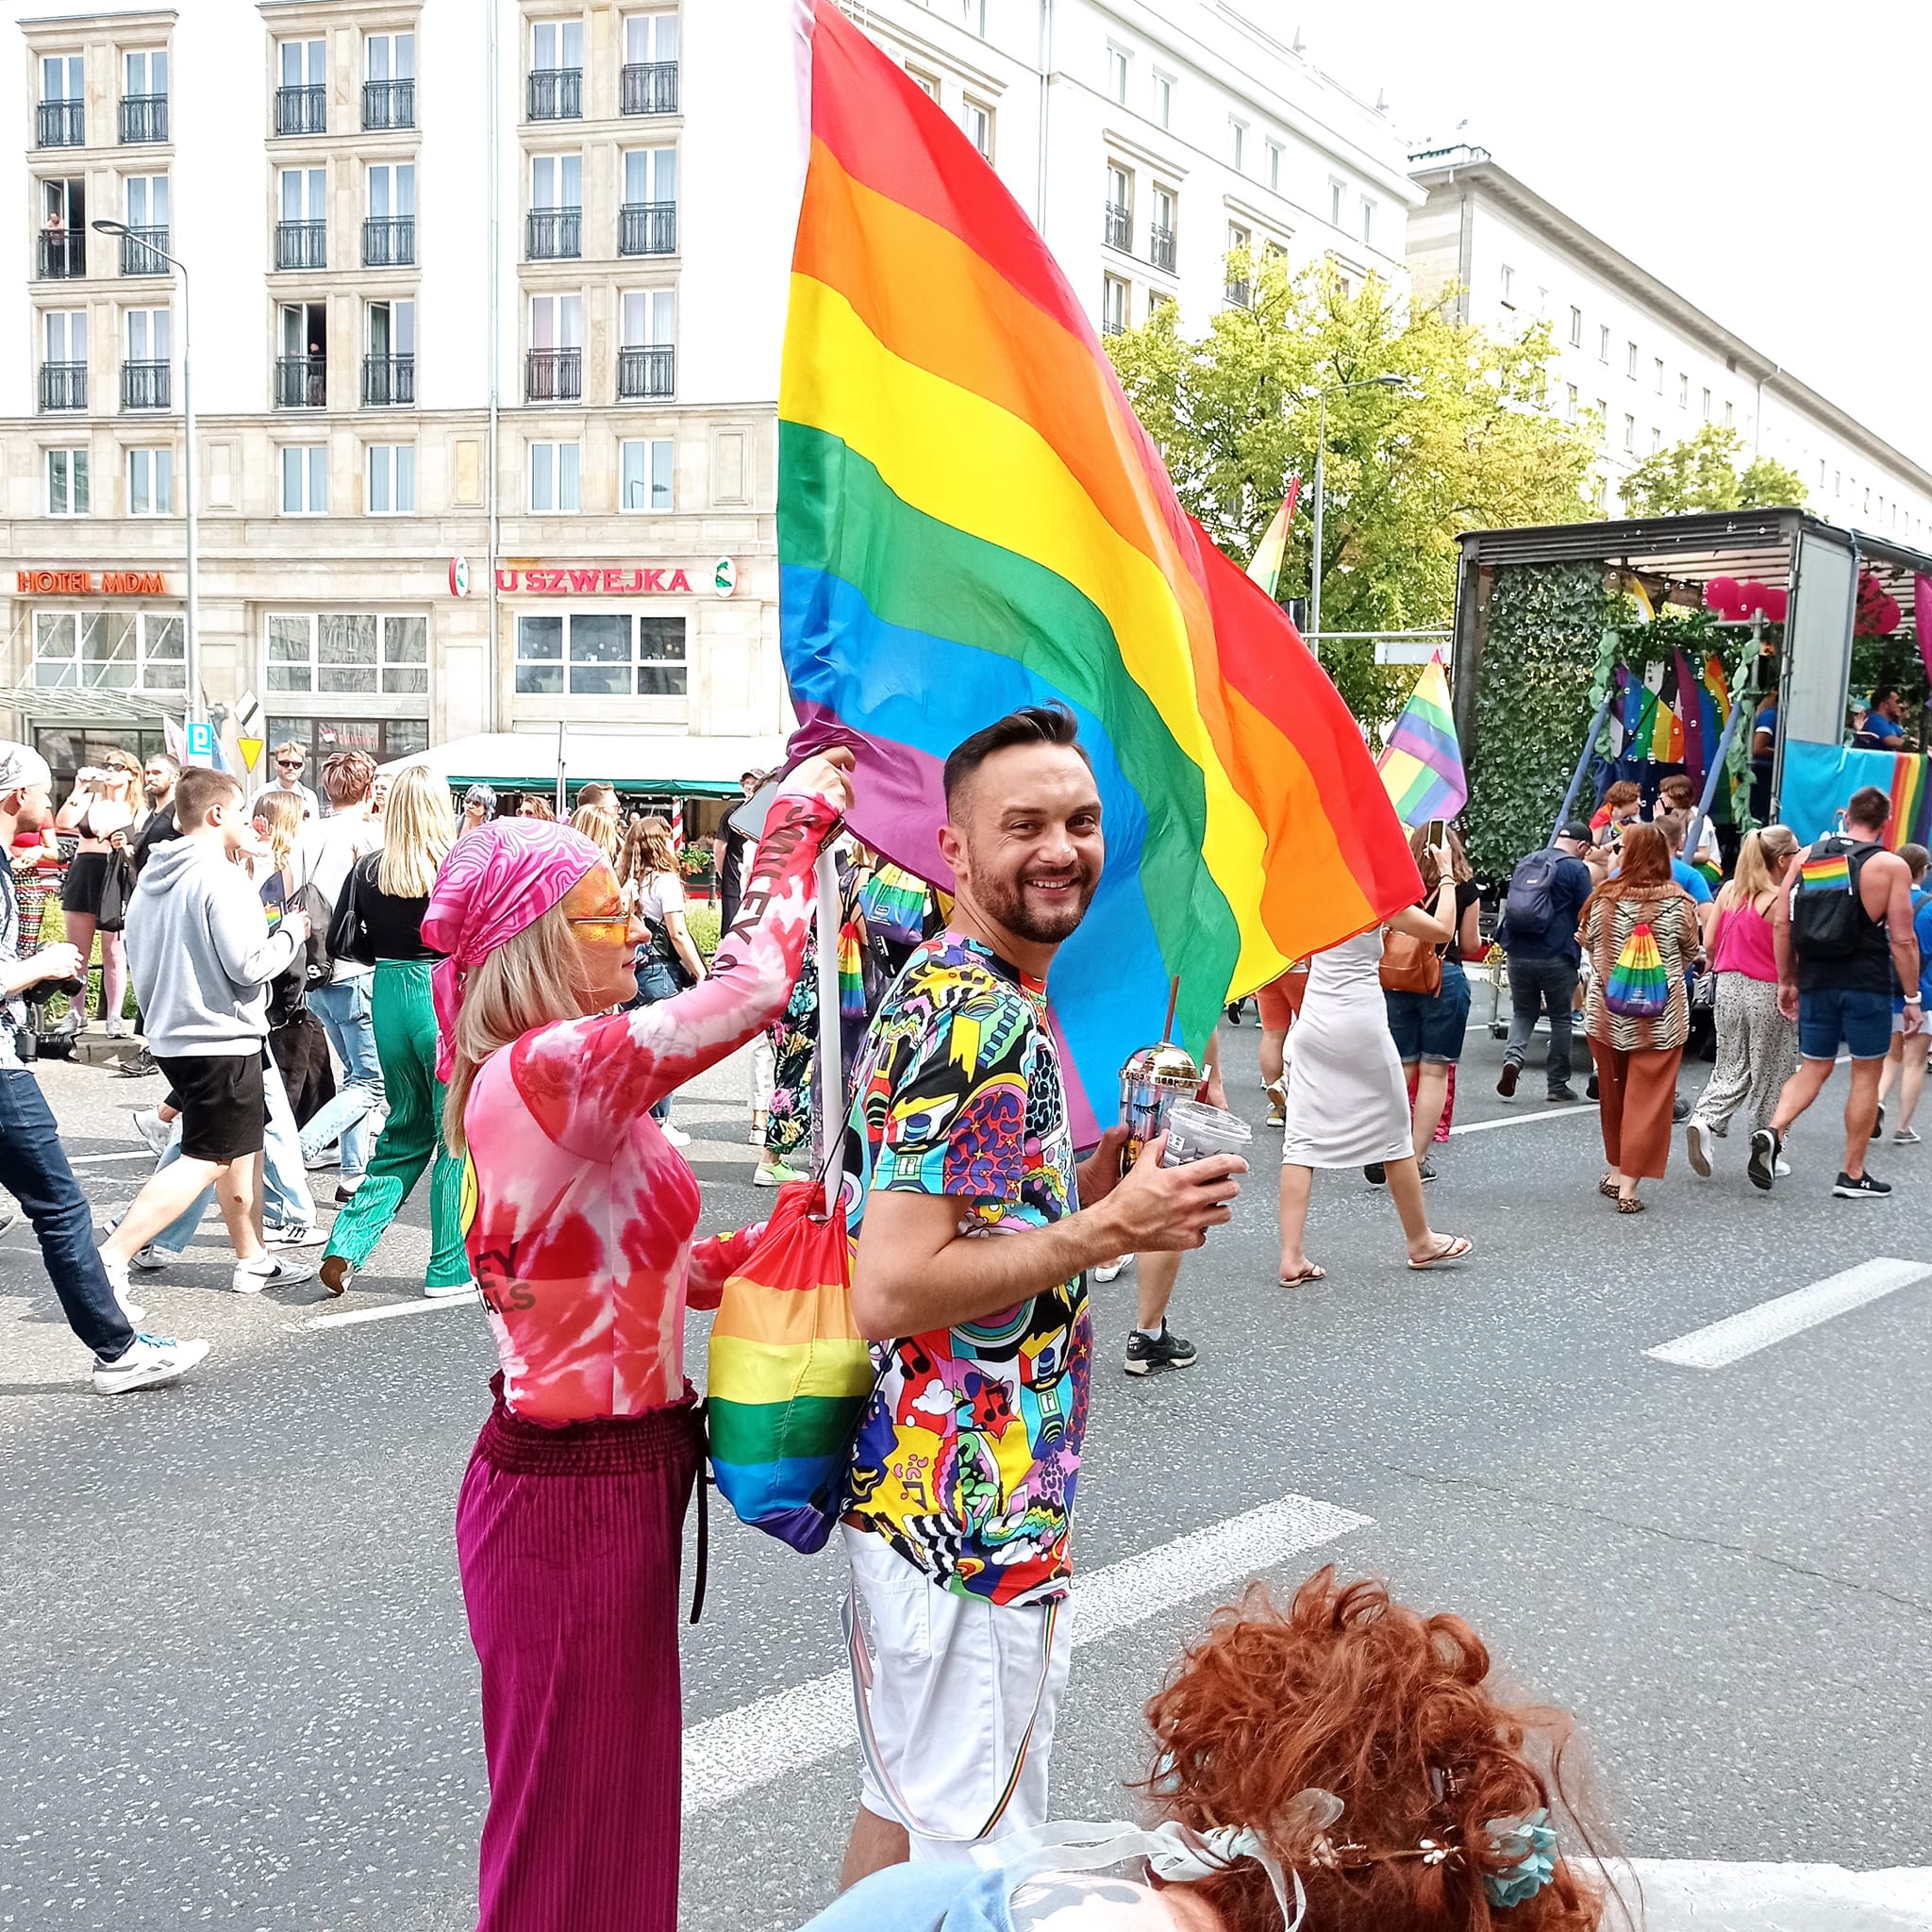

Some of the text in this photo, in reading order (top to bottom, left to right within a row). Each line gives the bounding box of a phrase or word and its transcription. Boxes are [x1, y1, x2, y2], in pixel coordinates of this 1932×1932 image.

[17, 571, 168, 592] HOTEL MDM
[495, 569, 692, 592] U SZWEJKA
[475, 1283, 536, 1315] ALS
